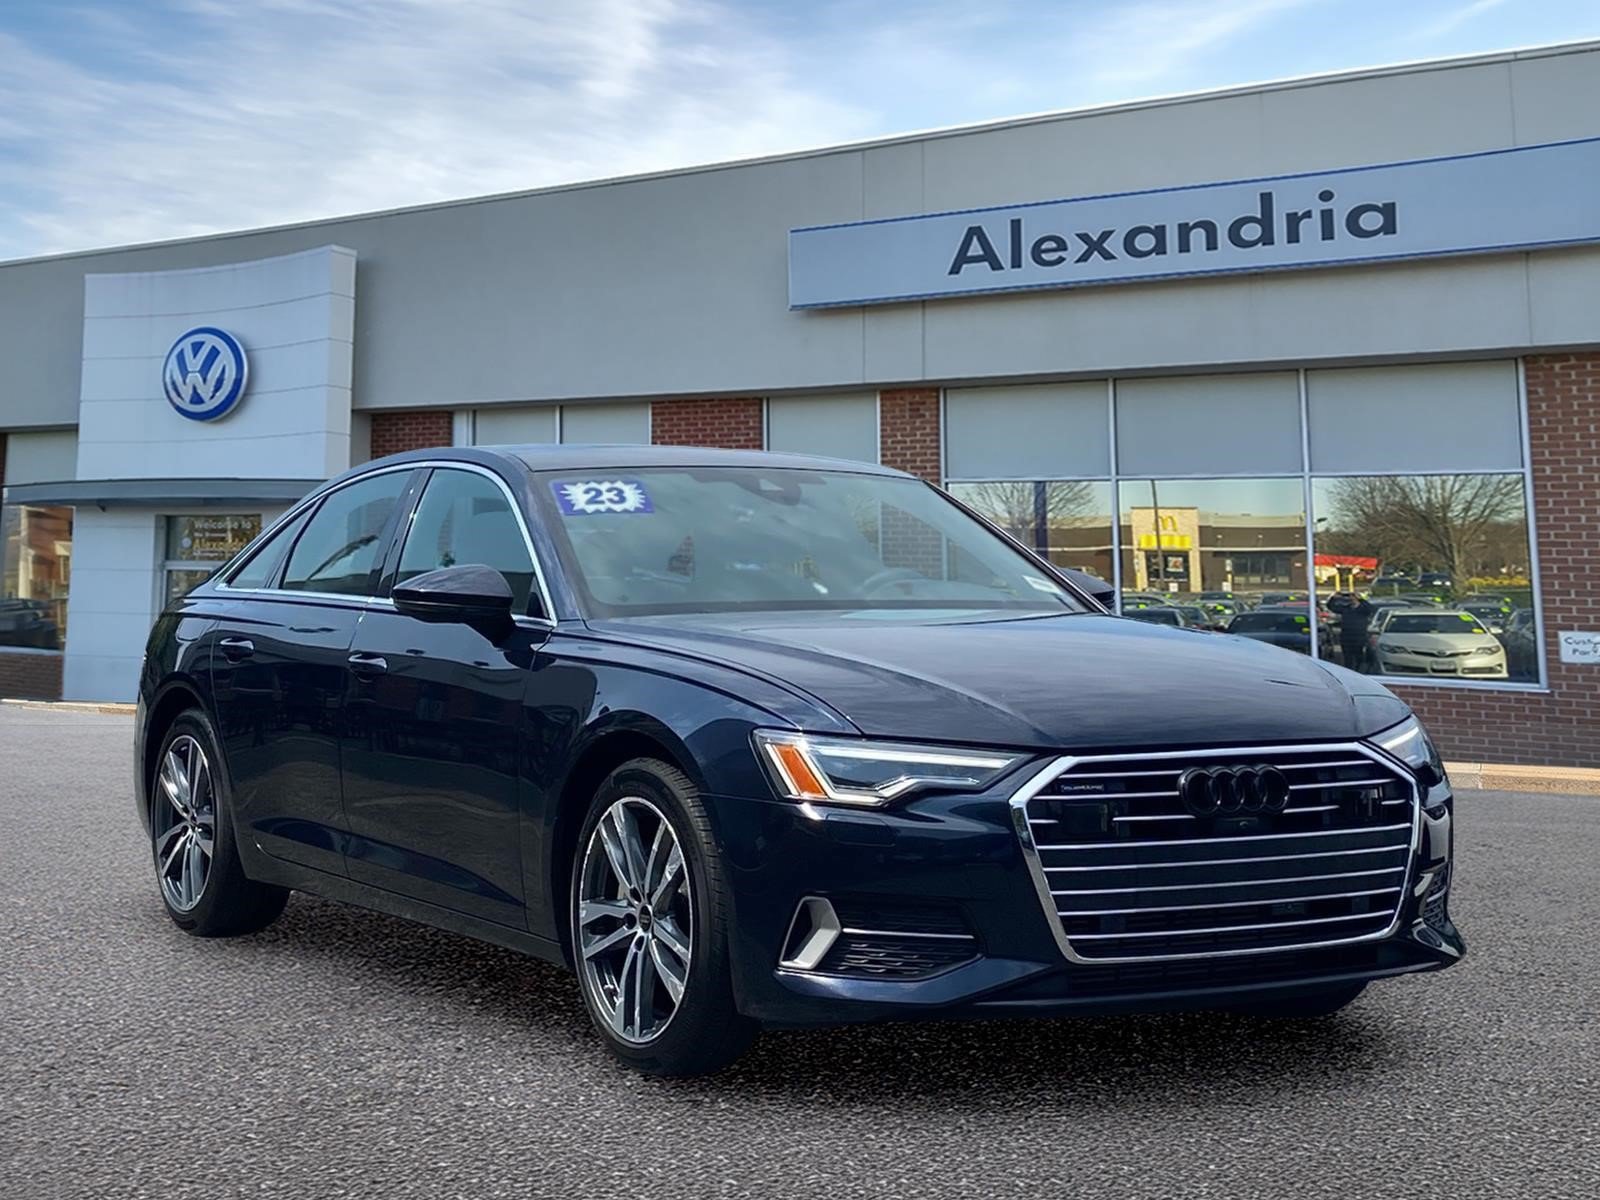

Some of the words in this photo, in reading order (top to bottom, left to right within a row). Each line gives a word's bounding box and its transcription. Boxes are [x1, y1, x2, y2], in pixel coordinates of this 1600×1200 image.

[948, 189, 1398, 275] Alexandria
[166, 331, 239, 414] VW
[583, 487, 627, 505] 23
